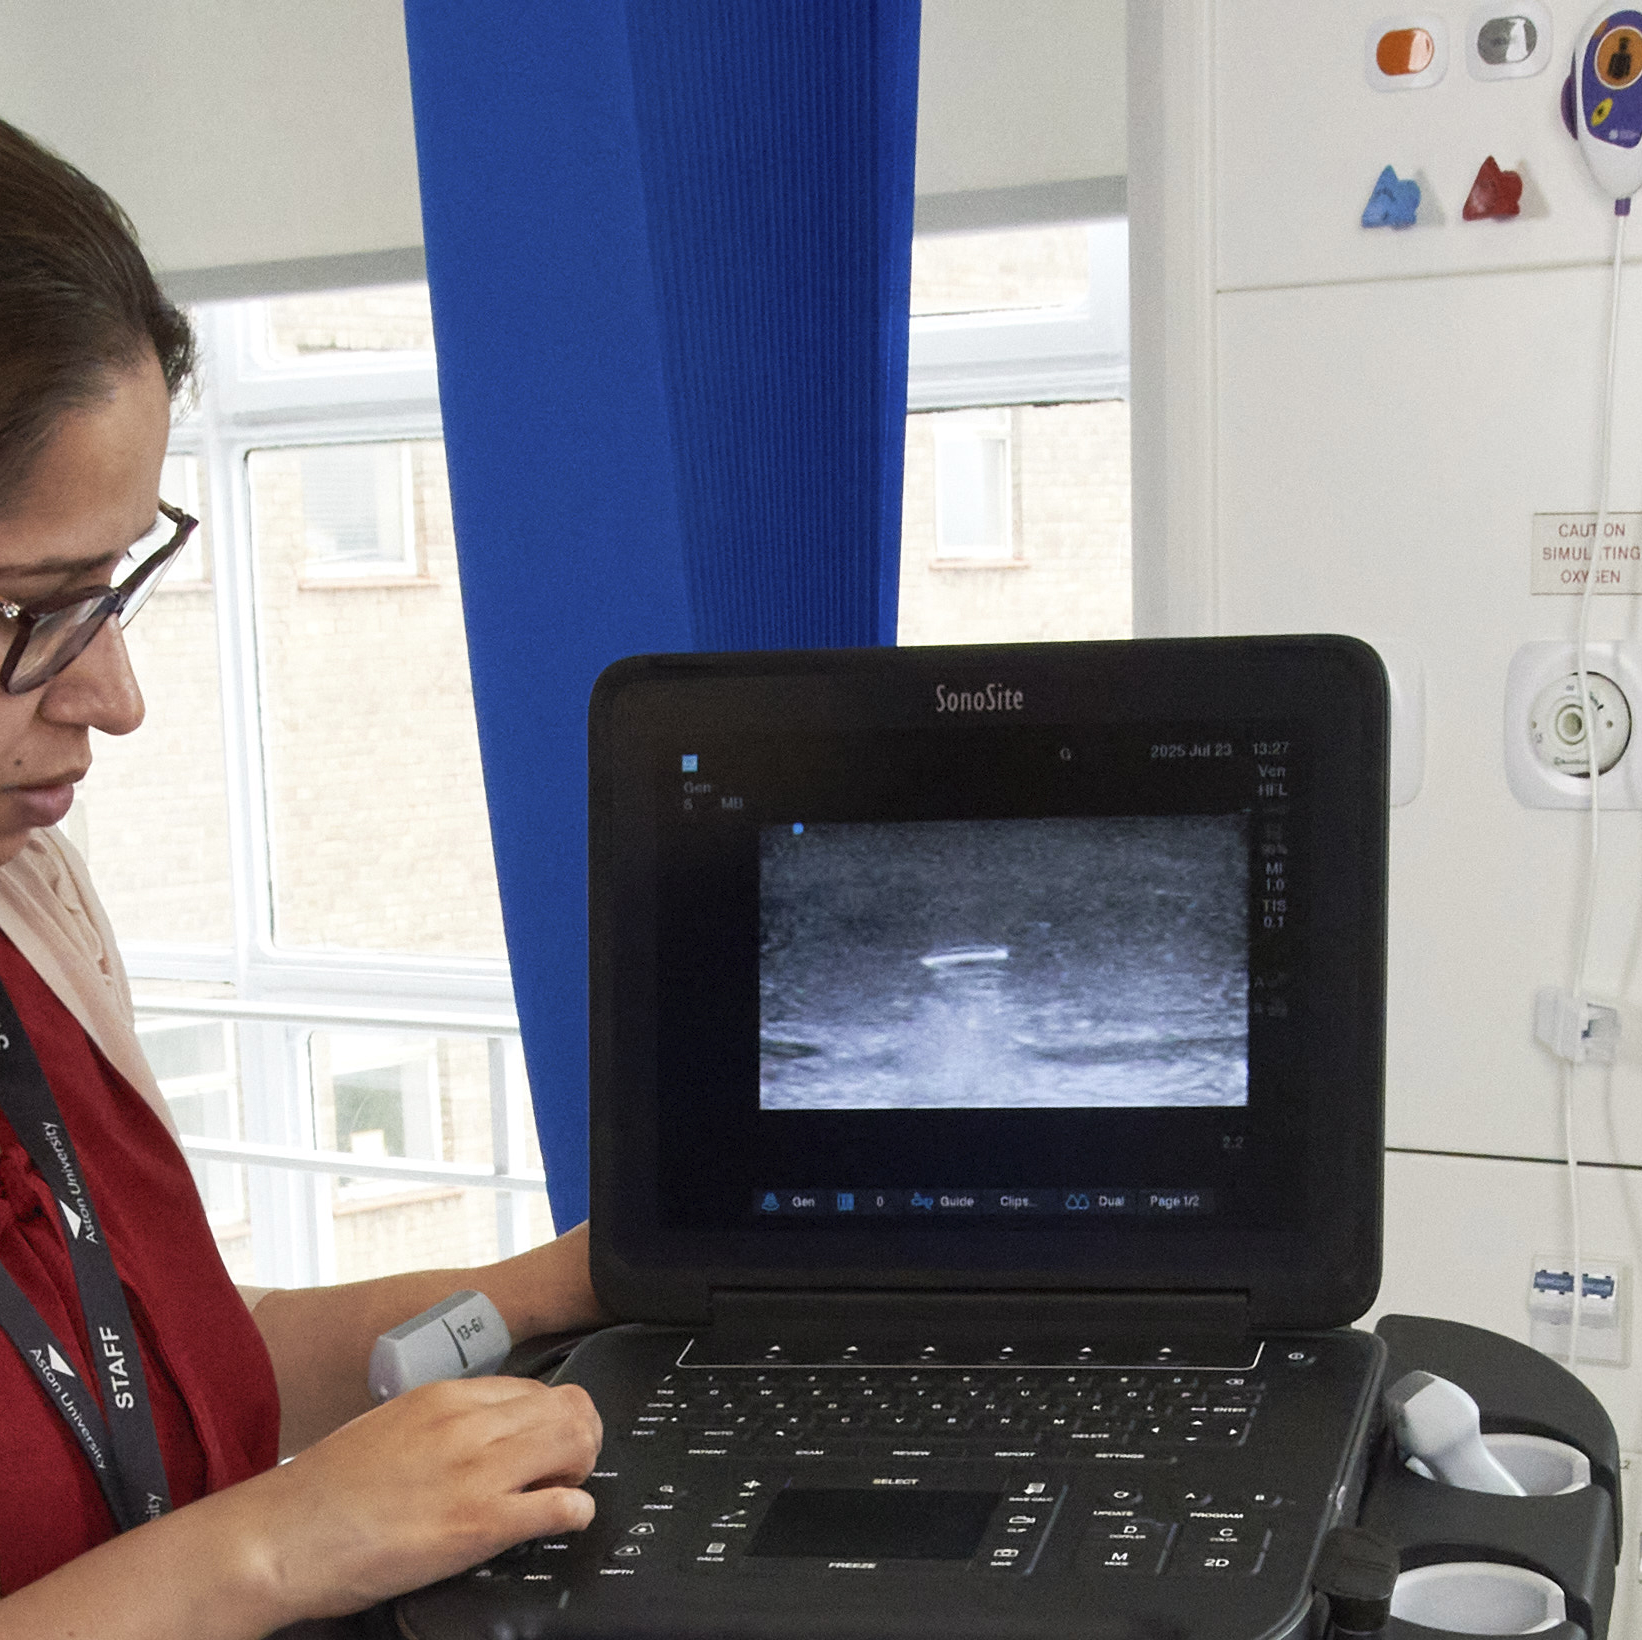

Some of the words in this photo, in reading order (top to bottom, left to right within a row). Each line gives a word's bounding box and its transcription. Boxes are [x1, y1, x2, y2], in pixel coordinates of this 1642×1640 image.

[1558, 522, 1626, 538] CAUTON
[1542, 545, 1641, 561] SIMULTING
[936, 682, 1024, 712] SonoSite
[1150, 744, 1186, 759] 2025
[1189, 744, 1211, 758] Jul
[1215, 743, 1233, 757] 23
[1253, 741, 1291, 756] 13:27
[1258, 763, 1287, 778] Ven
[42, 1121, 81, 1195] University
[791, 1196, 816, 1208] Gen
[940, 1195, 975, 1208] Guide
[1098, 1194, 1125, 1207] Dual
[1149, 1194, 1181, 1210] Page
[1183, 1194, 1200, 1207] 1/2
[76, 1197, 99, 1245] Aston
[98, 1326, 134, 1409] STAFF
[29, 1349, 62, 1393] Aston
[60, 1391, 107, 1469] University
[1189, 1511, 1244, 1519] PROGRAM
[1123, 1525, 1138, 1534] D
[1219, 1527, 1234, 1537] C
[1111, 1552, 1128, 1561] M
[1204, 1558, 1230, 1567] 2D
